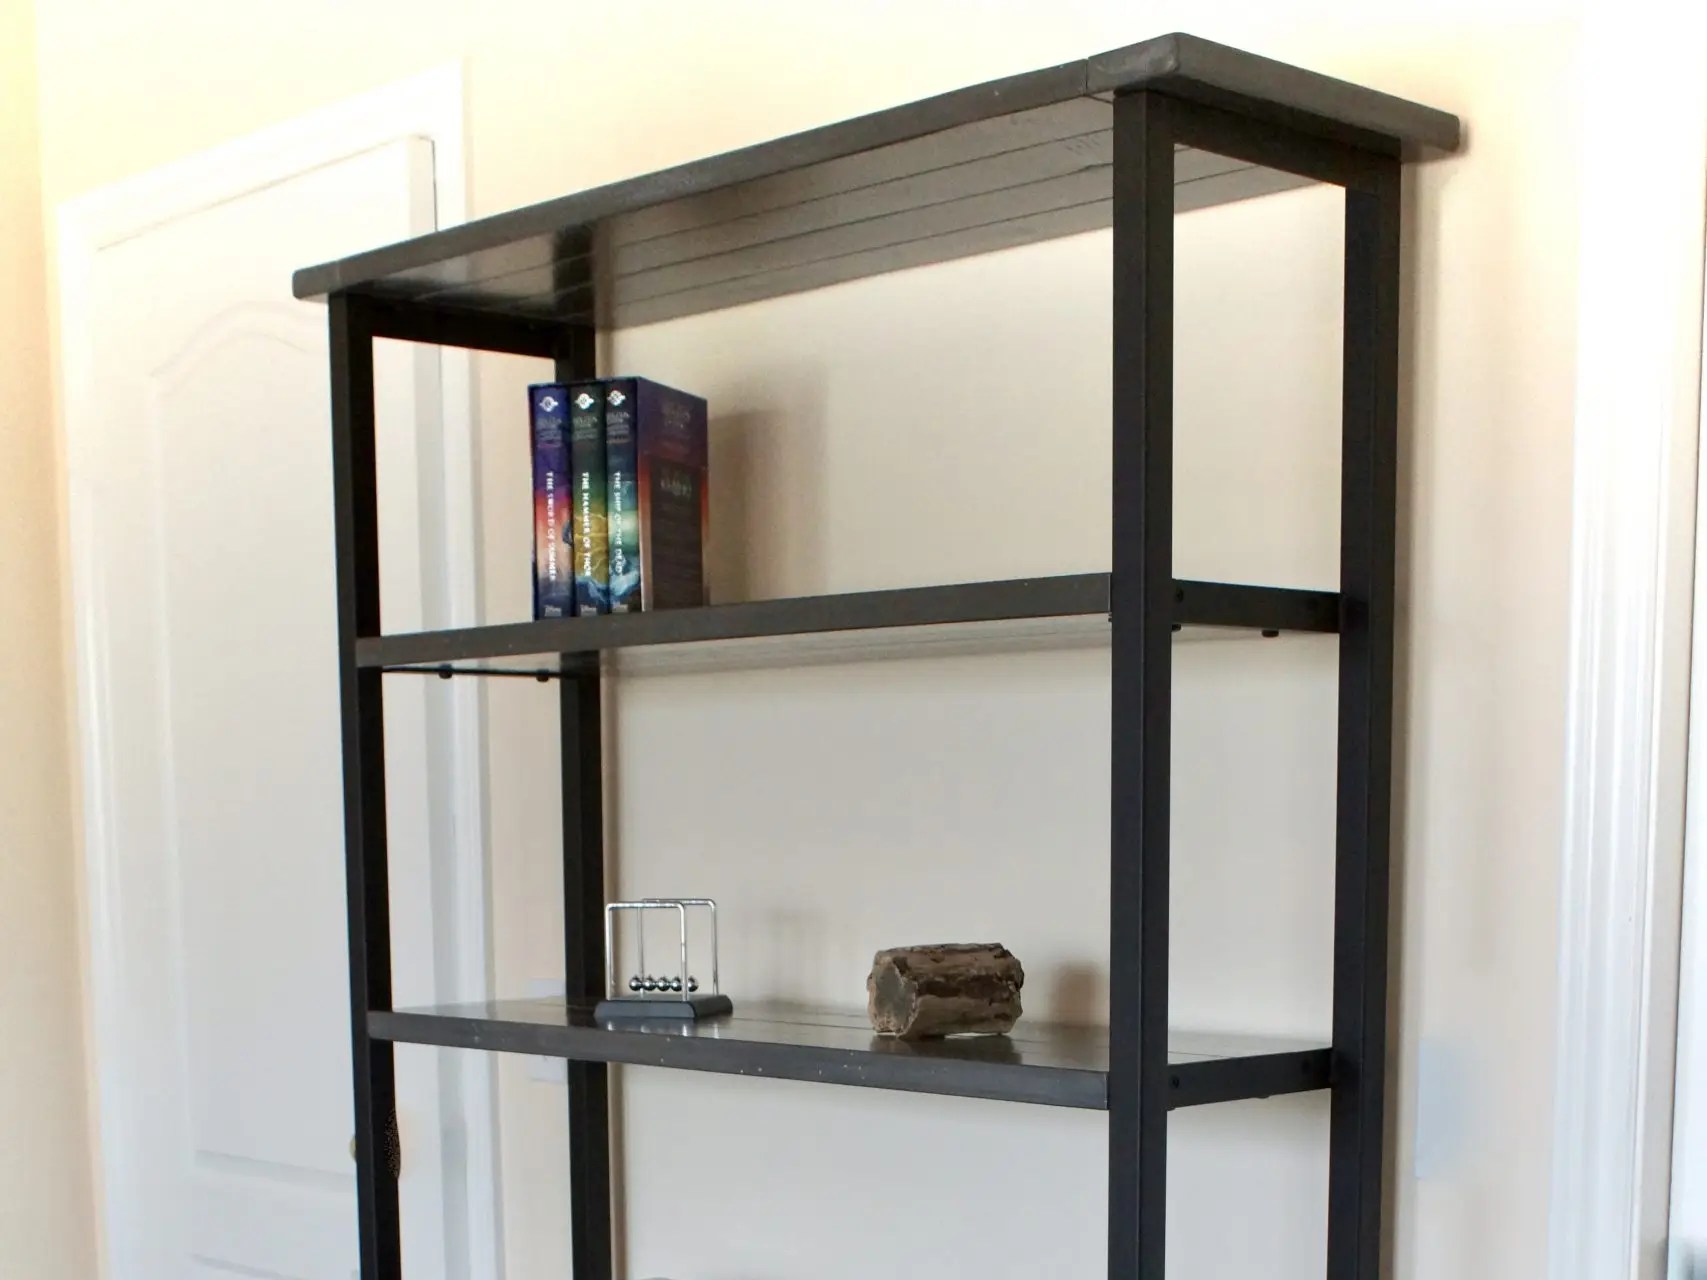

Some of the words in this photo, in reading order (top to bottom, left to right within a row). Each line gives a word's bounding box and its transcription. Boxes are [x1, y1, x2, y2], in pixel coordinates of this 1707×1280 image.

[582, 472, 590, 490] THE
[582, 492, 591, 534] HAMMER
[583, 537, 591, 548] OF
[584, 552, 592, 576] THOR
[615, 548, 623, 574] DEAD
